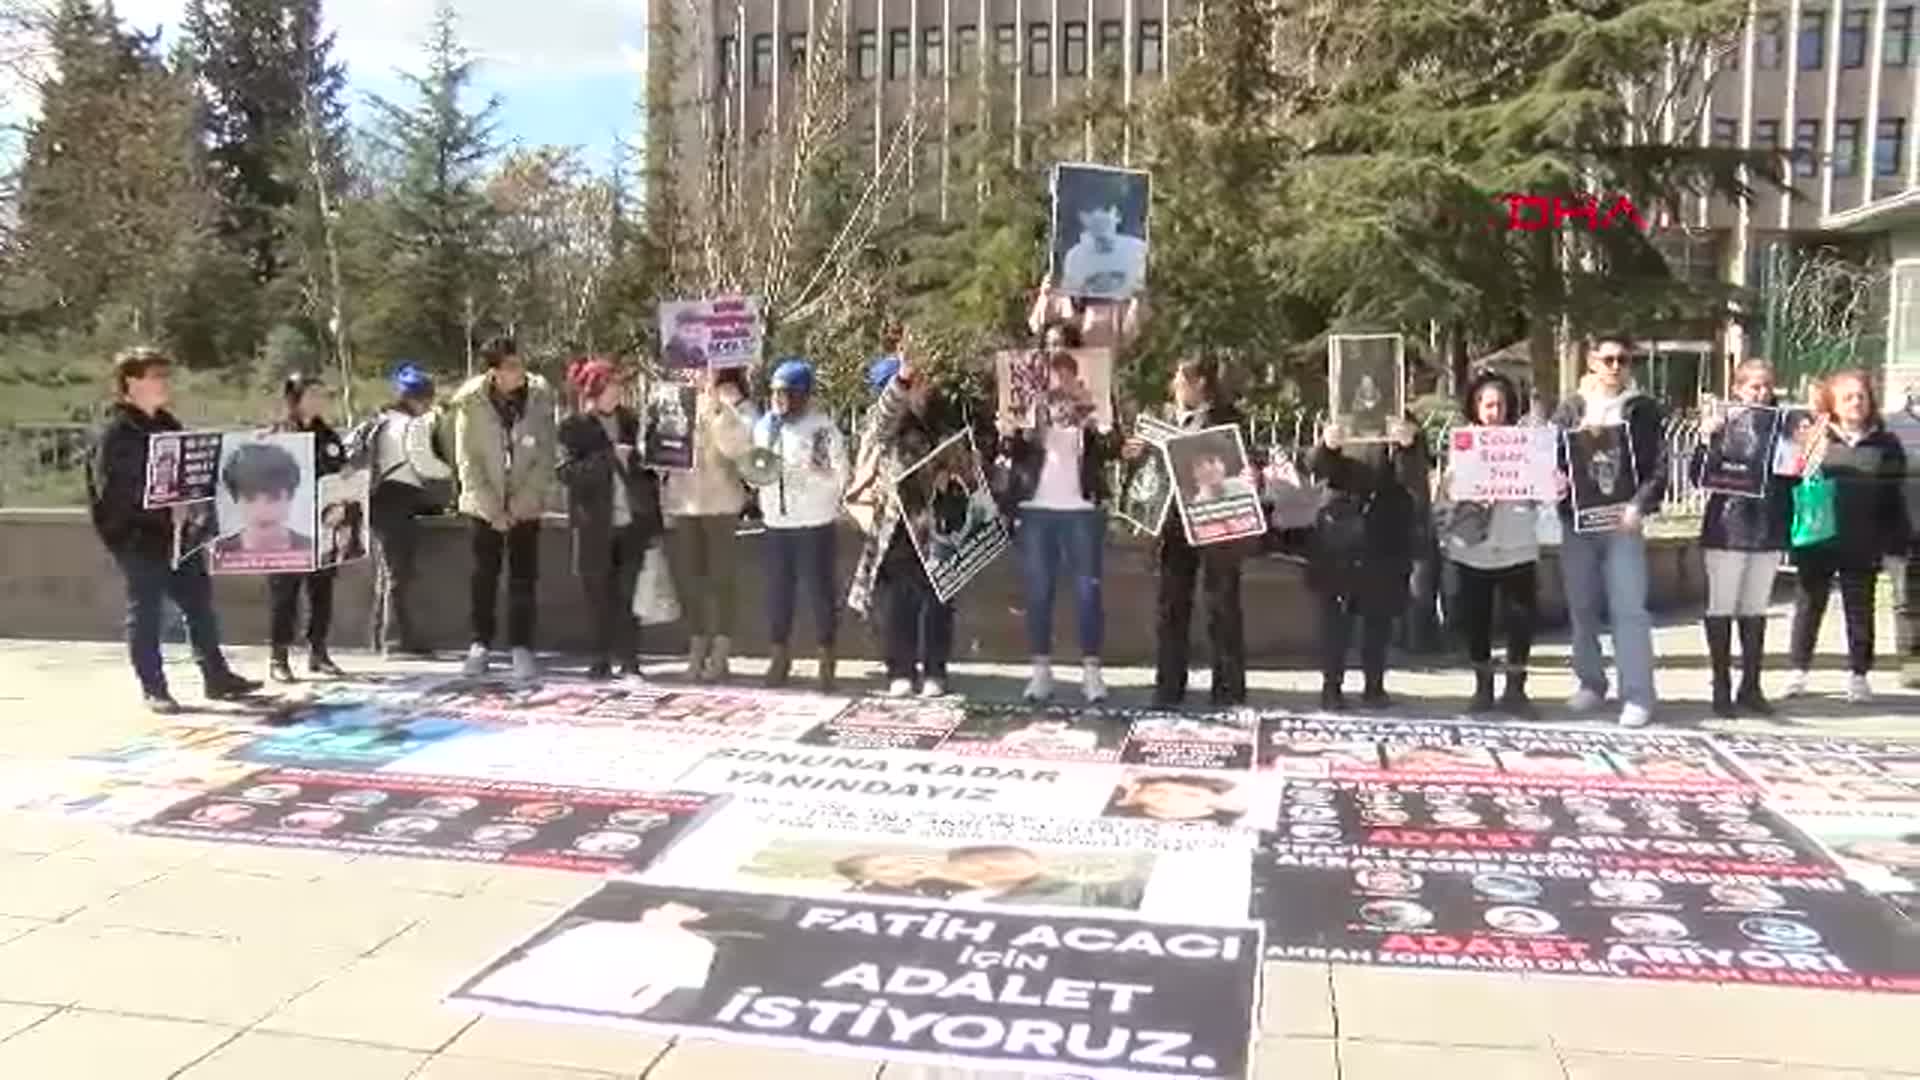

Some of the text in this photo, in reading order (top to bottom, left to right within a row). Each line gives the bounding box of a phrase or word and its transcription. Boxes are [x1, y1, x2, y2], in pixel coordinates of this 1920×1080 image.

[705, 748, 1061, 783] SONUNA KADAR
[726, 770, 1001, 801] YANINDAYIZ
[1368, 829, 1536, 848] ADALET
[797, 907, 1240, 961] FATİH ACACI
[1382, 934, 1590, 959] ADALET
[821, 961, 1155, 1014] ADALET
[715, 985, 1218, 1070] İSTİYORUZ.
